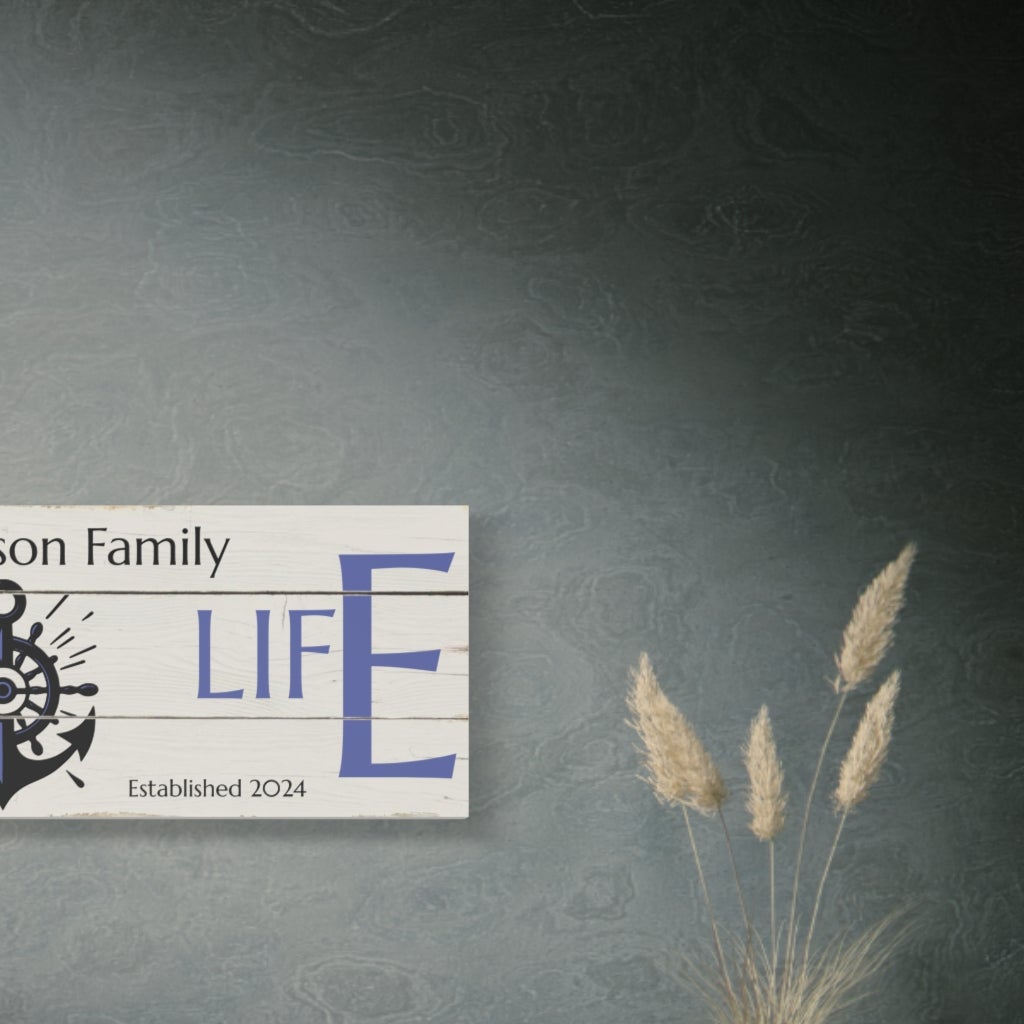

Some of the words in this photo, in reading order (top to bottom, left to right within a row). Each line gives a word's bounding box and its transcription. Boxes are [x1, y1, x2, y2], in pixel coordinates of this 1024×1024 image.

[86, 526, 231, 578] Family
[197, 552, 457, 779] LIFE
[128, 778, 242, 798] Established
[249, 779, 307, 798] 2024
